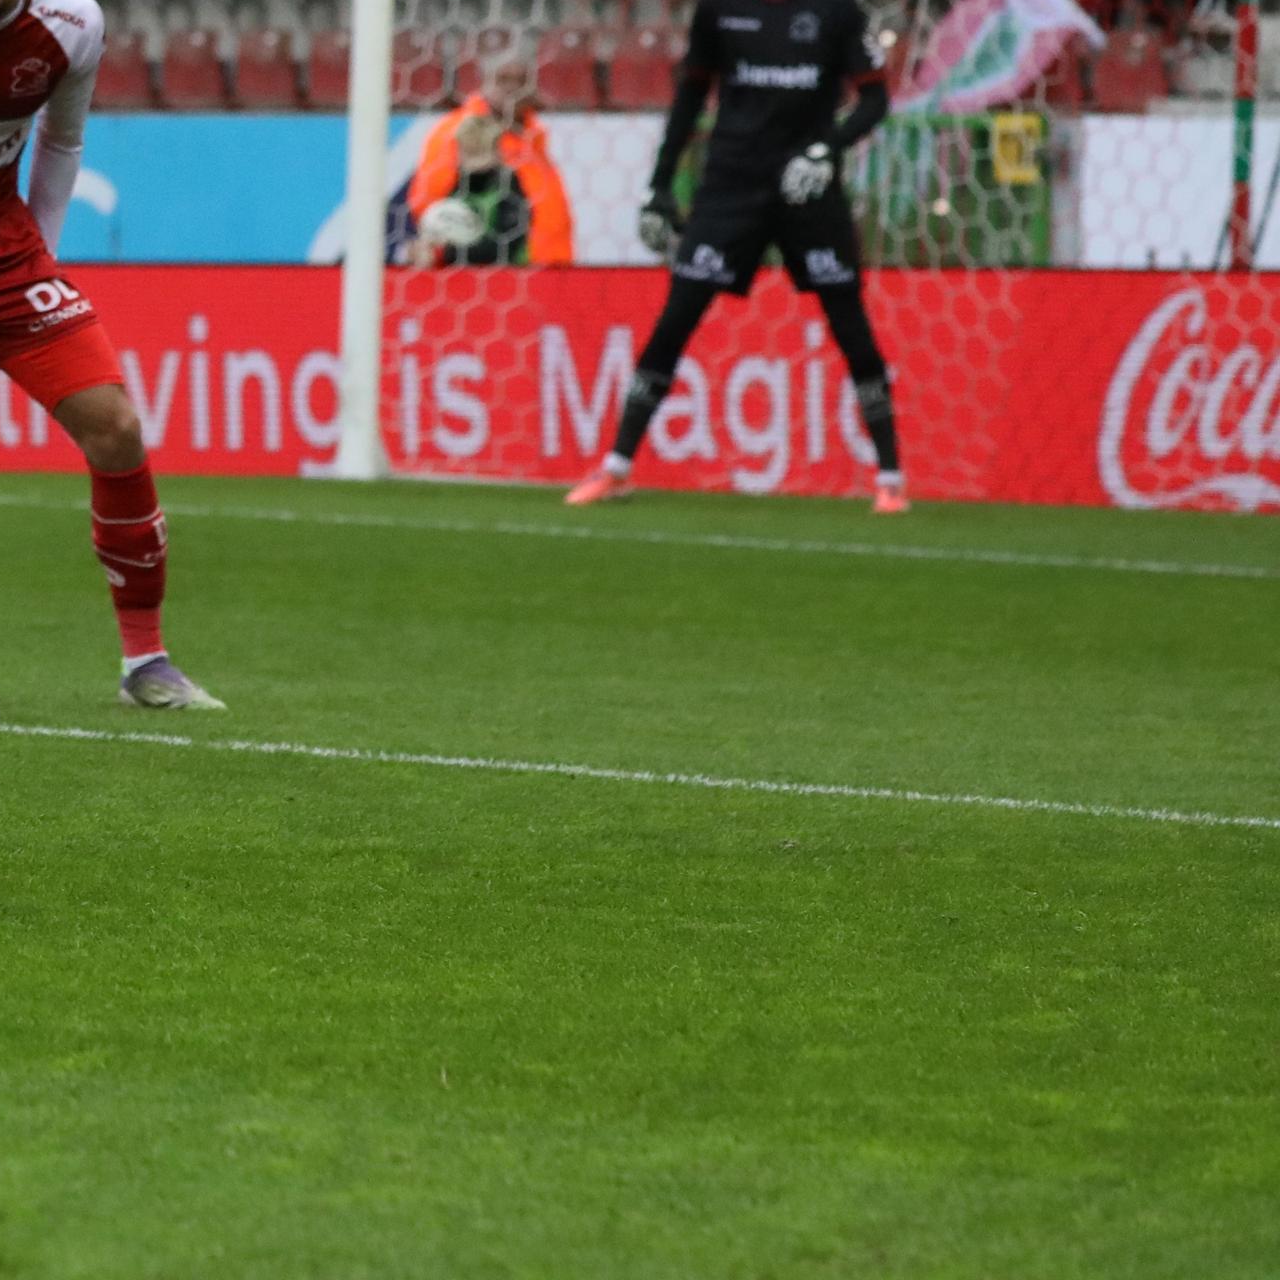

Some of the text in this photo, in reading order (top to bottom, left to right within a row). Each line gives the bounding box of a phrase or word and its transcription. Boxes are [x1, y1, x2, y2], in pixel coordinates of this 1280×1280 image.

[25, 278, 80, 313] DL
[397, 319, 489, 458] is
[540, 324, 892, 493] Magic
